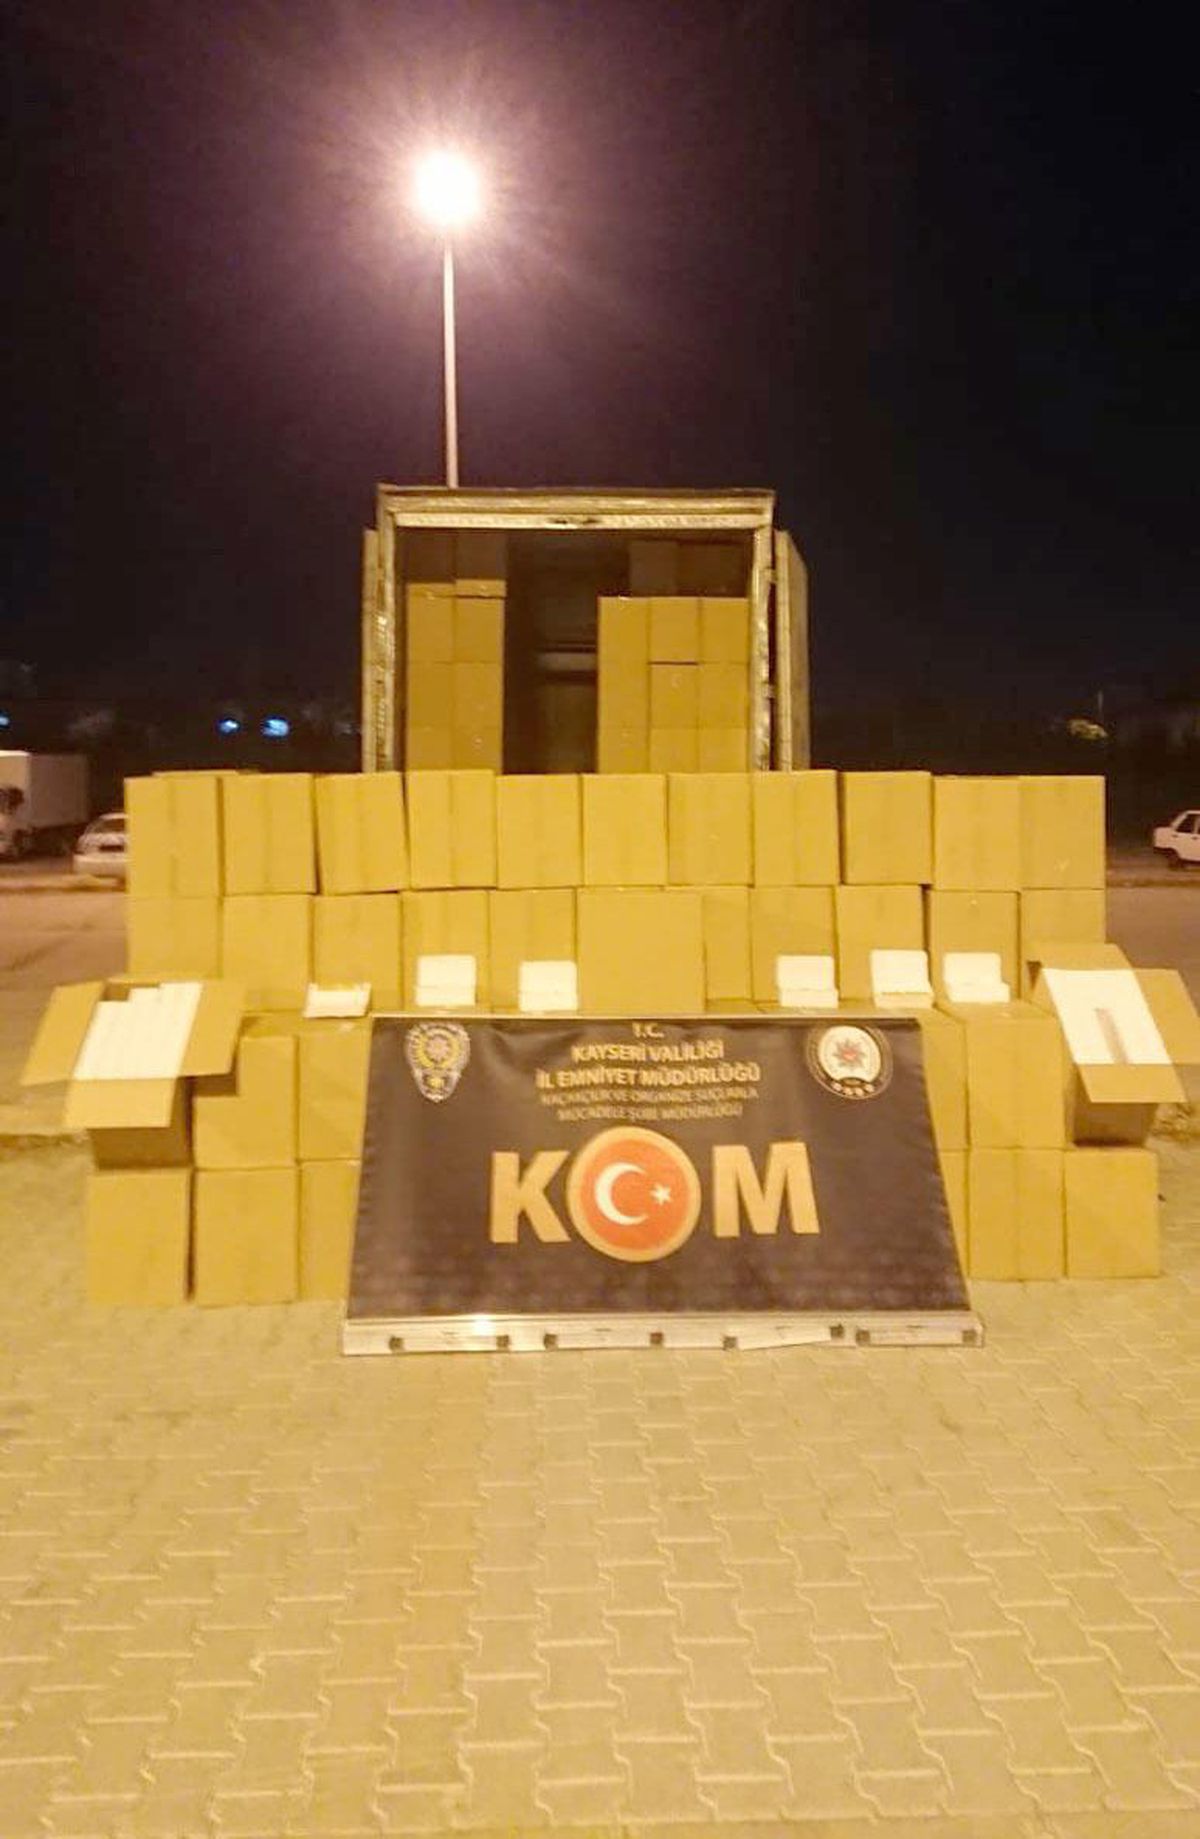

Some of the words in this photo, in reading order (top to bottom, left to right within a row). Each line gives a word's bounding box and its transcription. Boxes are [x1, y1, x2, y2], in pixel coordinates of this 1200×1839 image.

[631, 1022, 665, 1038] T.C.
[571, 1043, 646, 1063] KAYSERİ
[536, 1069, 555, 1089] İL
[557, 1066, 638, 1088] EMNİYET
[640, 1061, 761, 1086] MÜDÜRLÜĞÜ
[490, 1126, 820, 1262] KOM
